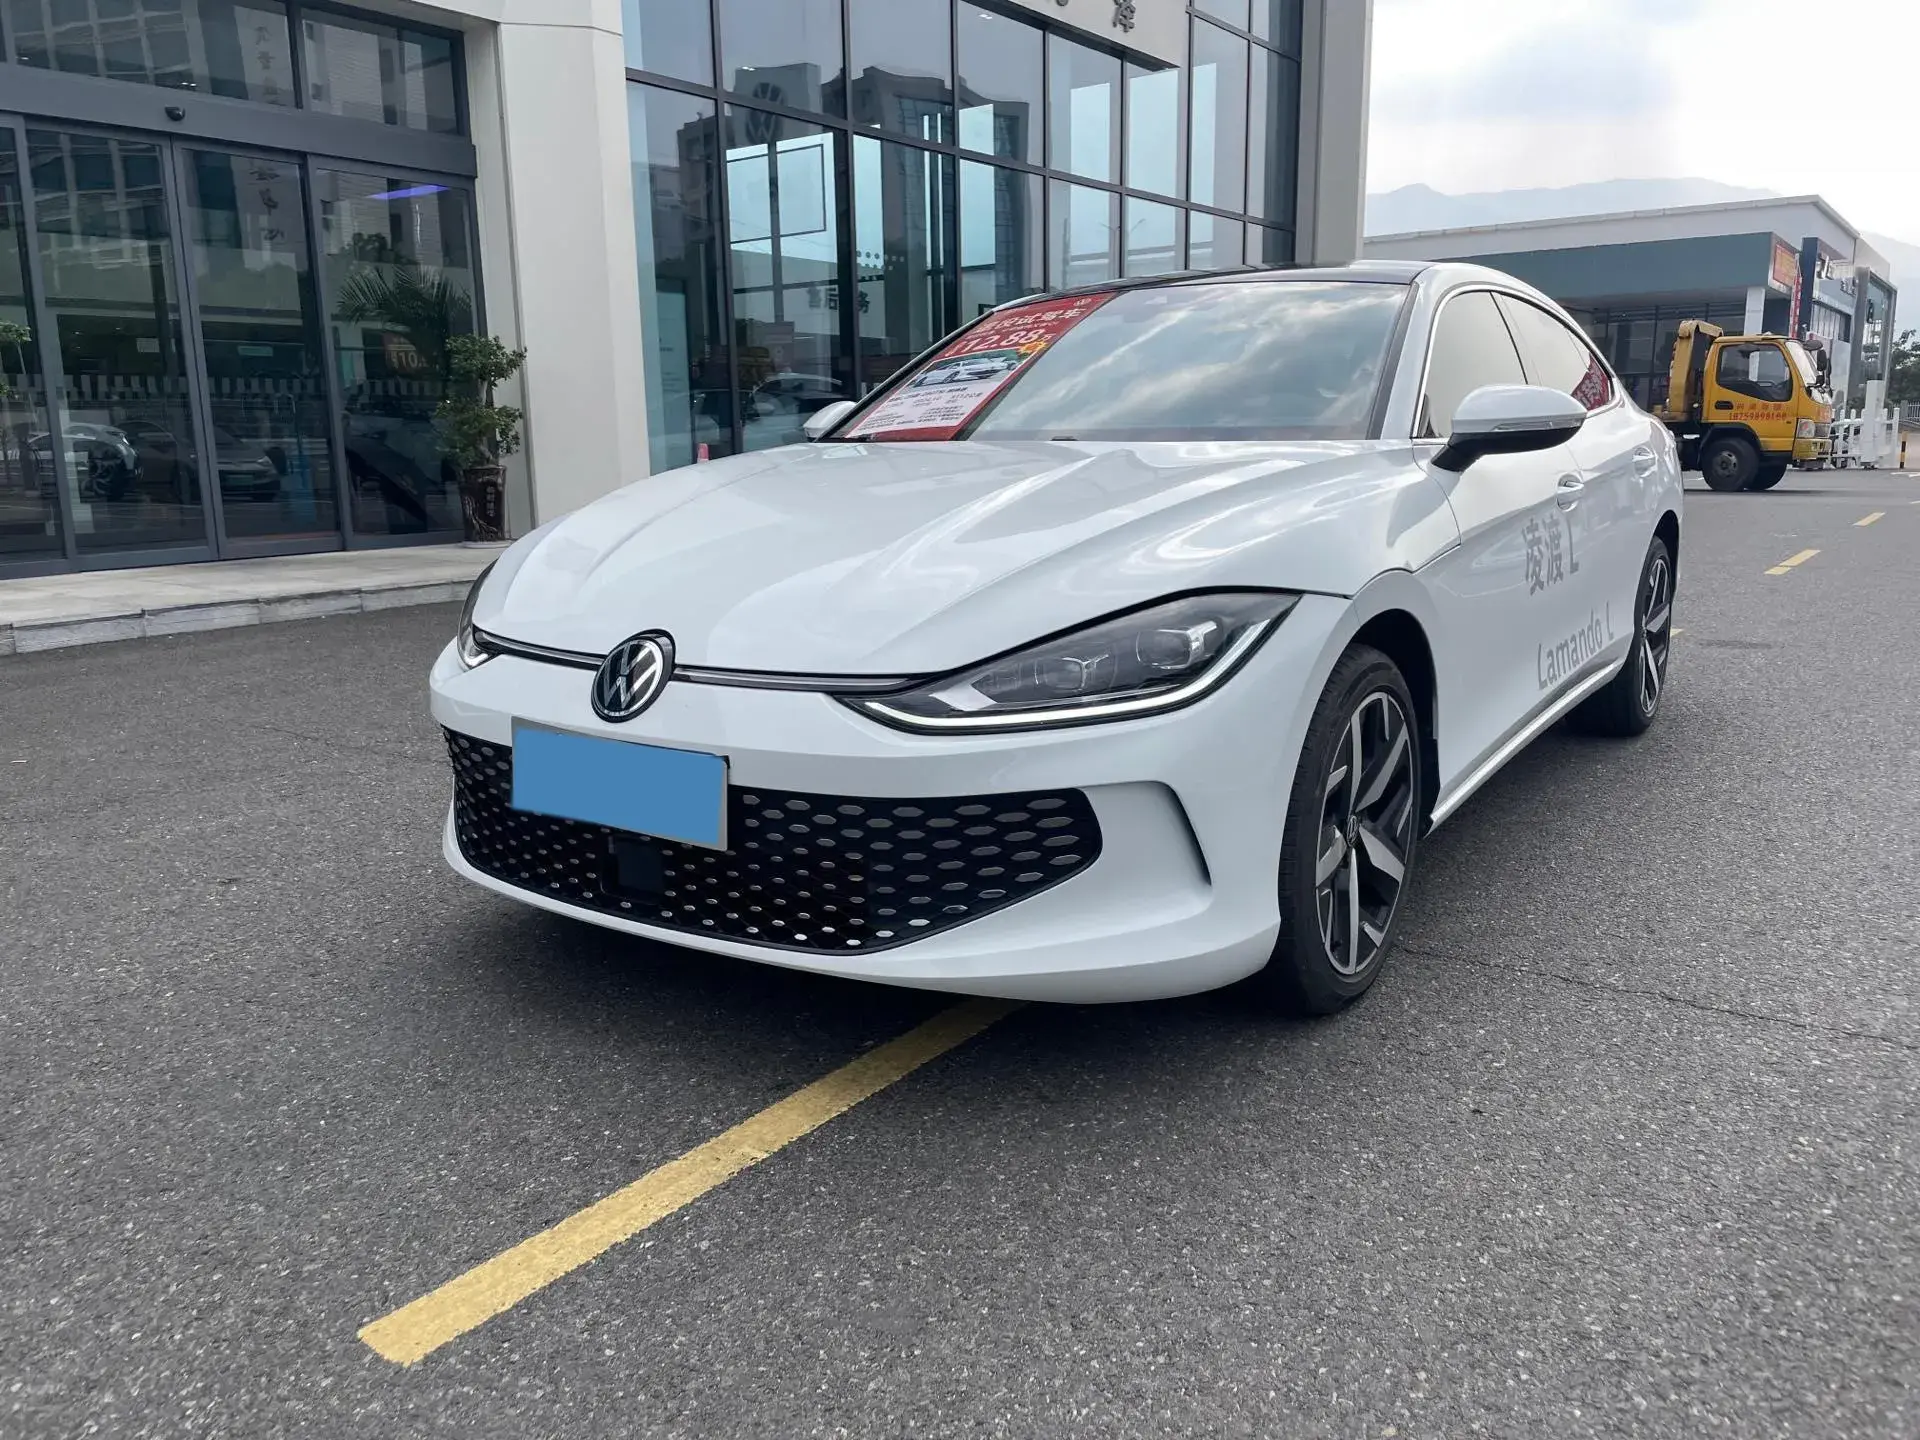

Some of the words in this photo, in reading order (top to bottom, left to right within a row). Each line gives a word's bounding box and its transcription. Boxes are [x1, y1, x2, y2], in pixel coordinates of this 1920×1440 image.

[806, 286, 870, 314] 售后务
[1521, 514, 1564, 595] 凌渡
[1566, 515, 1579, 574] L
[1537, 609, 1603, 690] Lamando
[1604, 601, 1615, 641] L
